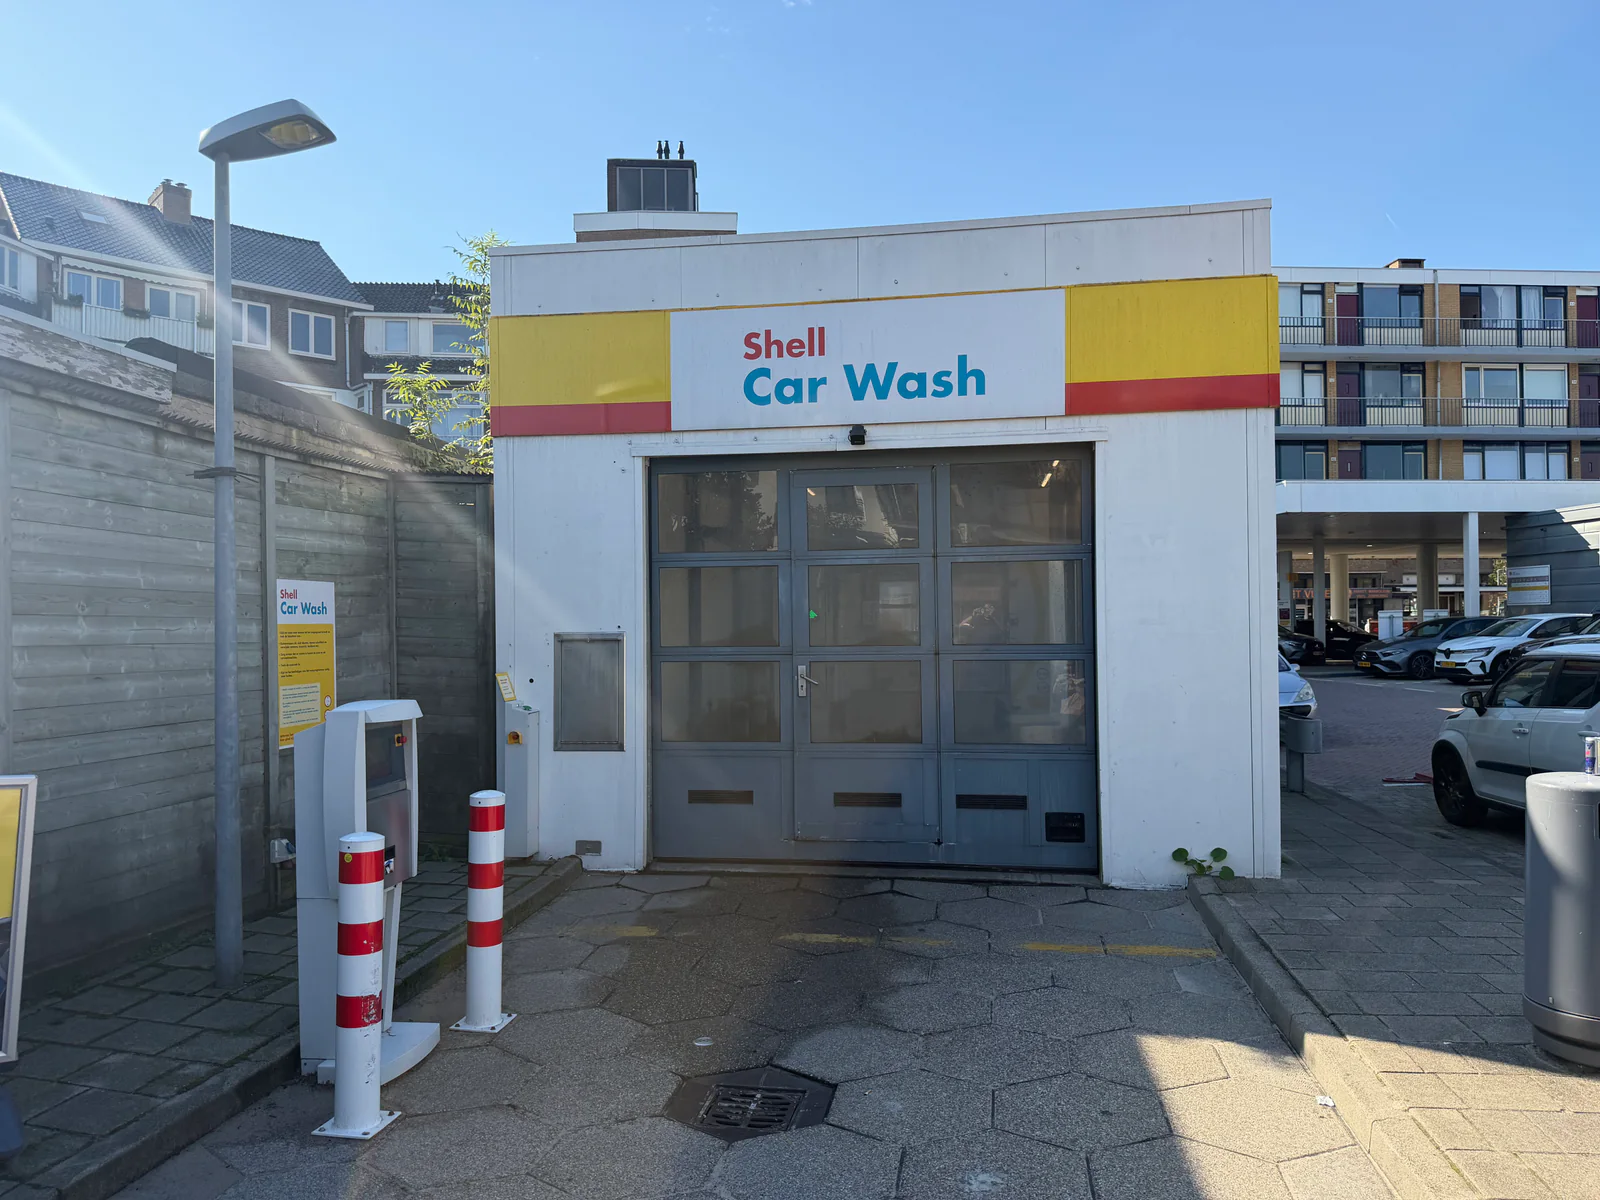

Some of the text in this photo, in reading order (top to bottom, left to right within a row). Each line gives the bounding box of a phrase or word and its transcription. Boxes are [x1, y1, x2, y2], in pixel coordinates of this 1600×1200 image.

[743, 326, 826, 361] Shell
[743, 354, 986, 406] Car Wash
[280, 589, 298, 600] Shell
[280, 601, 328, 615] Car Wash
